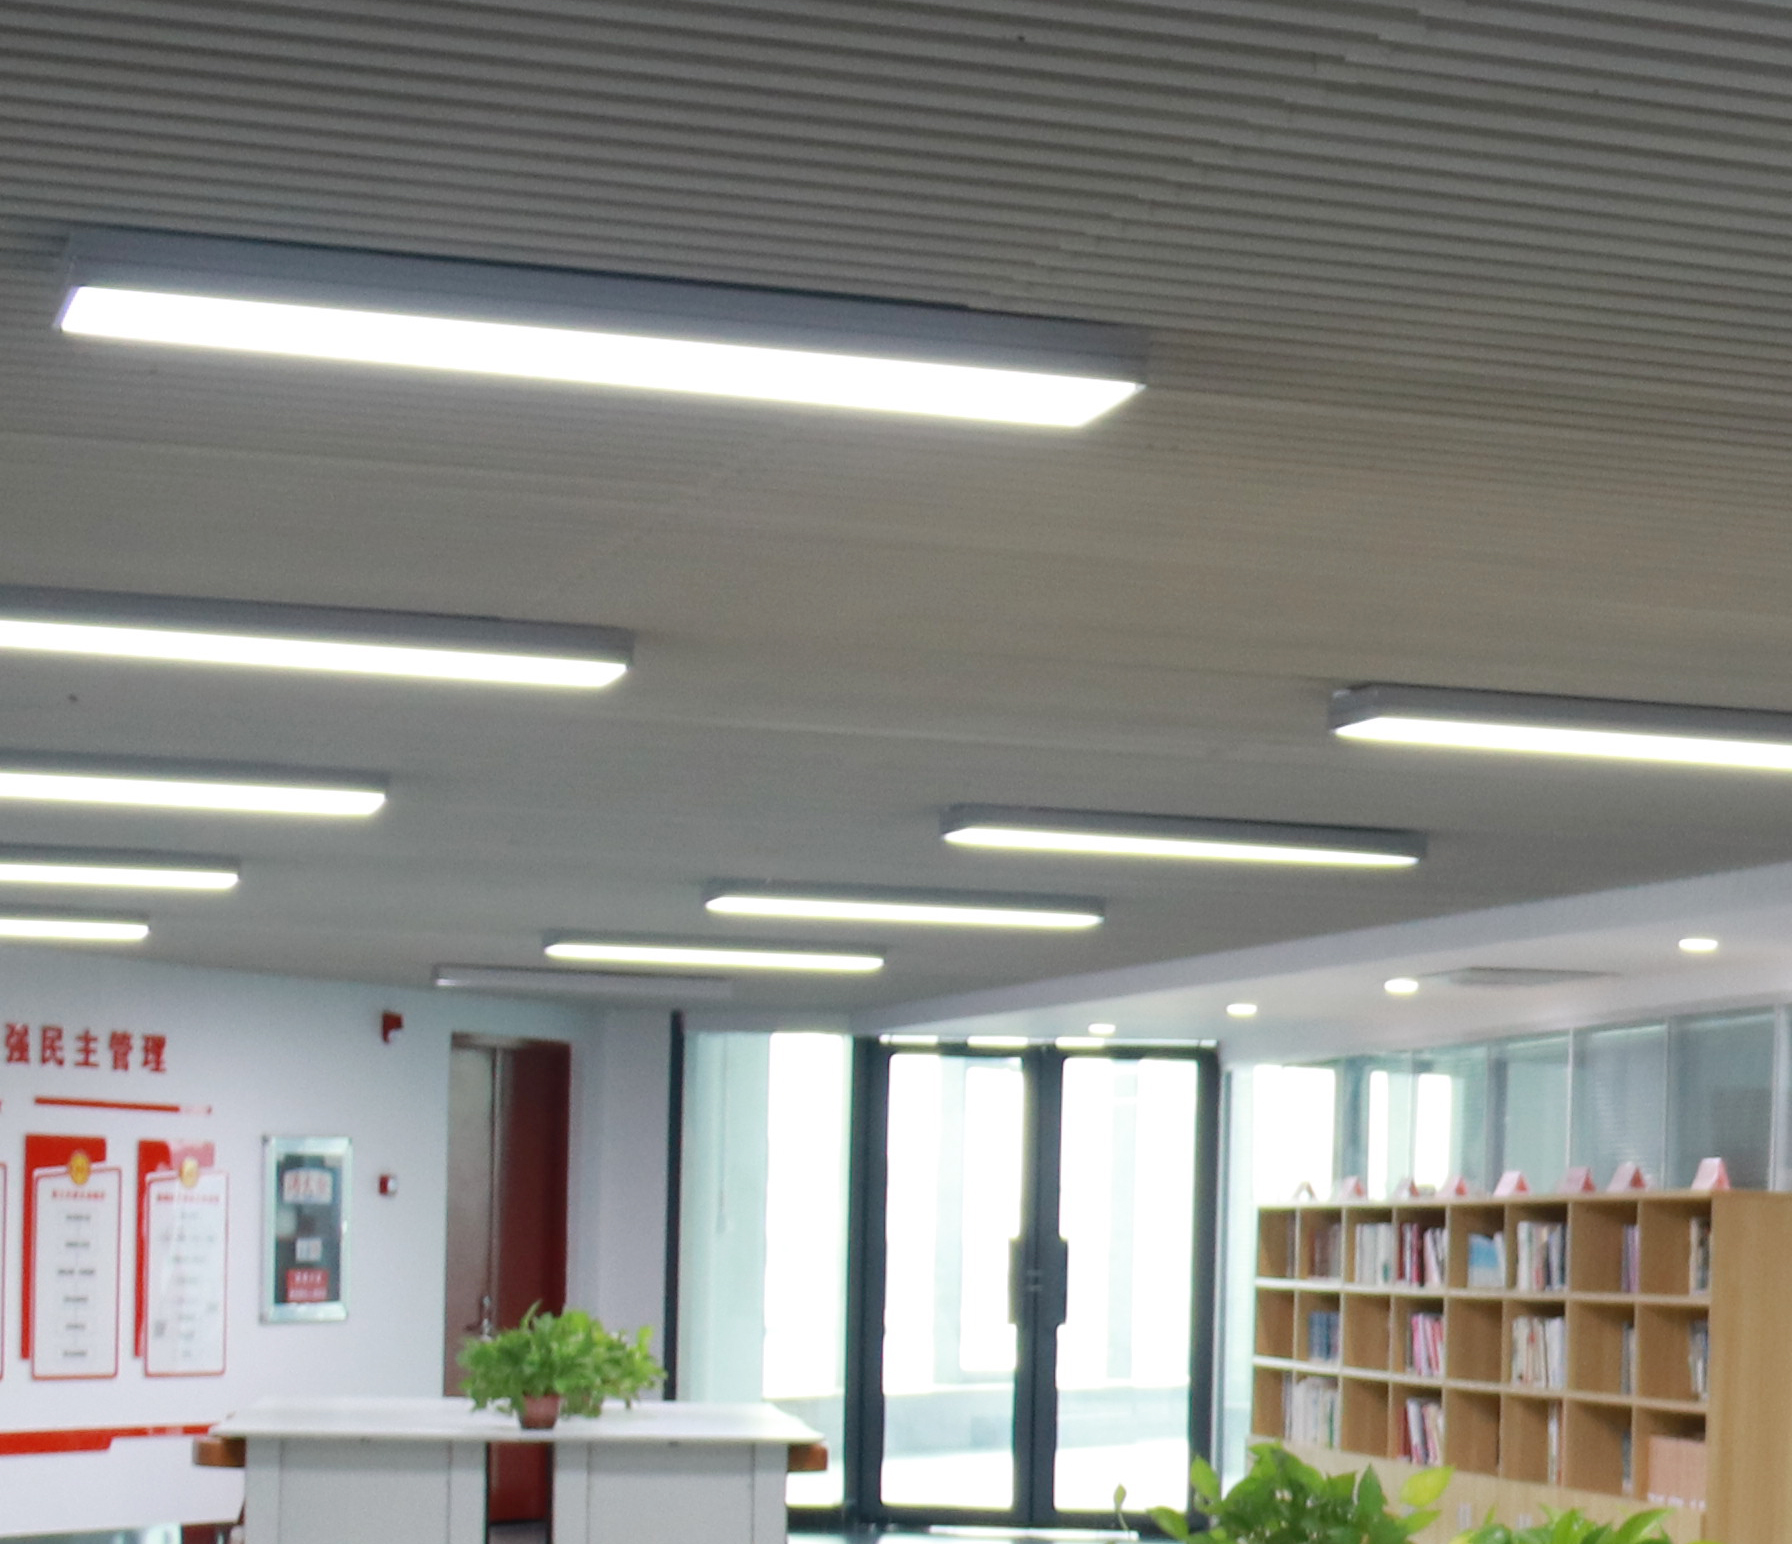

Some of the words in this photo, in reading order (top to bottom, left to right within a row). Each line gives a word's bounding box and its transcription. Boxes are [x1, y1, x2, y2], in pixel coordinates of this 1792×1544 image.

[5, 1023, 167, 1073] 强民主管理
